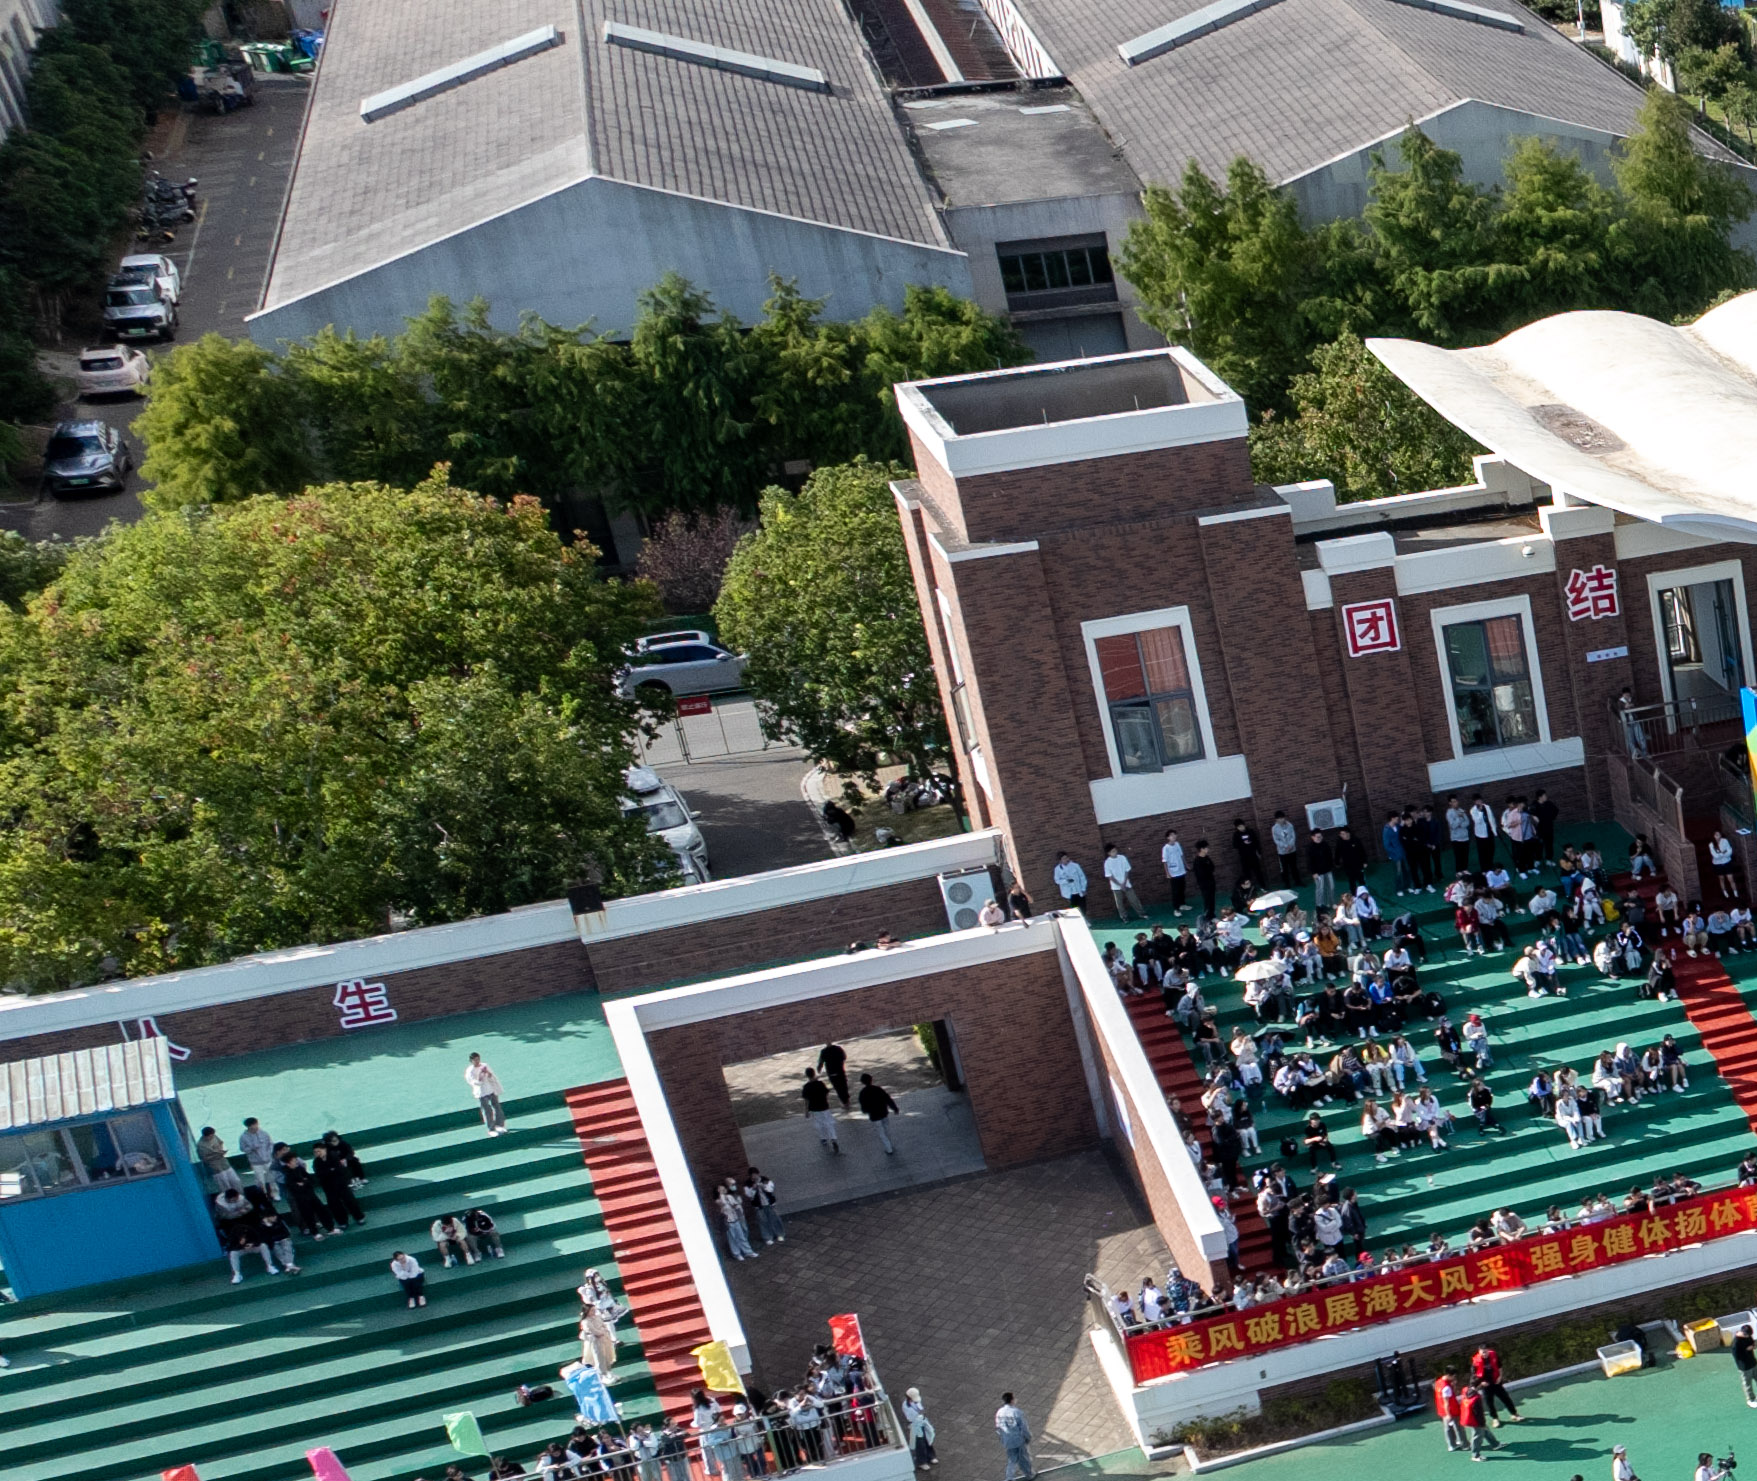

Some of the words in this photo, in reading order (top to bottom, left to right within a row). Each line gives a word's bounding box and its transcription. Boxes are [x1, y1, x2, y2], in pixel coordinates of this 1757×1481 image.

[1165, 1256, 1511, 1367] 乘风破浪展海大风采
